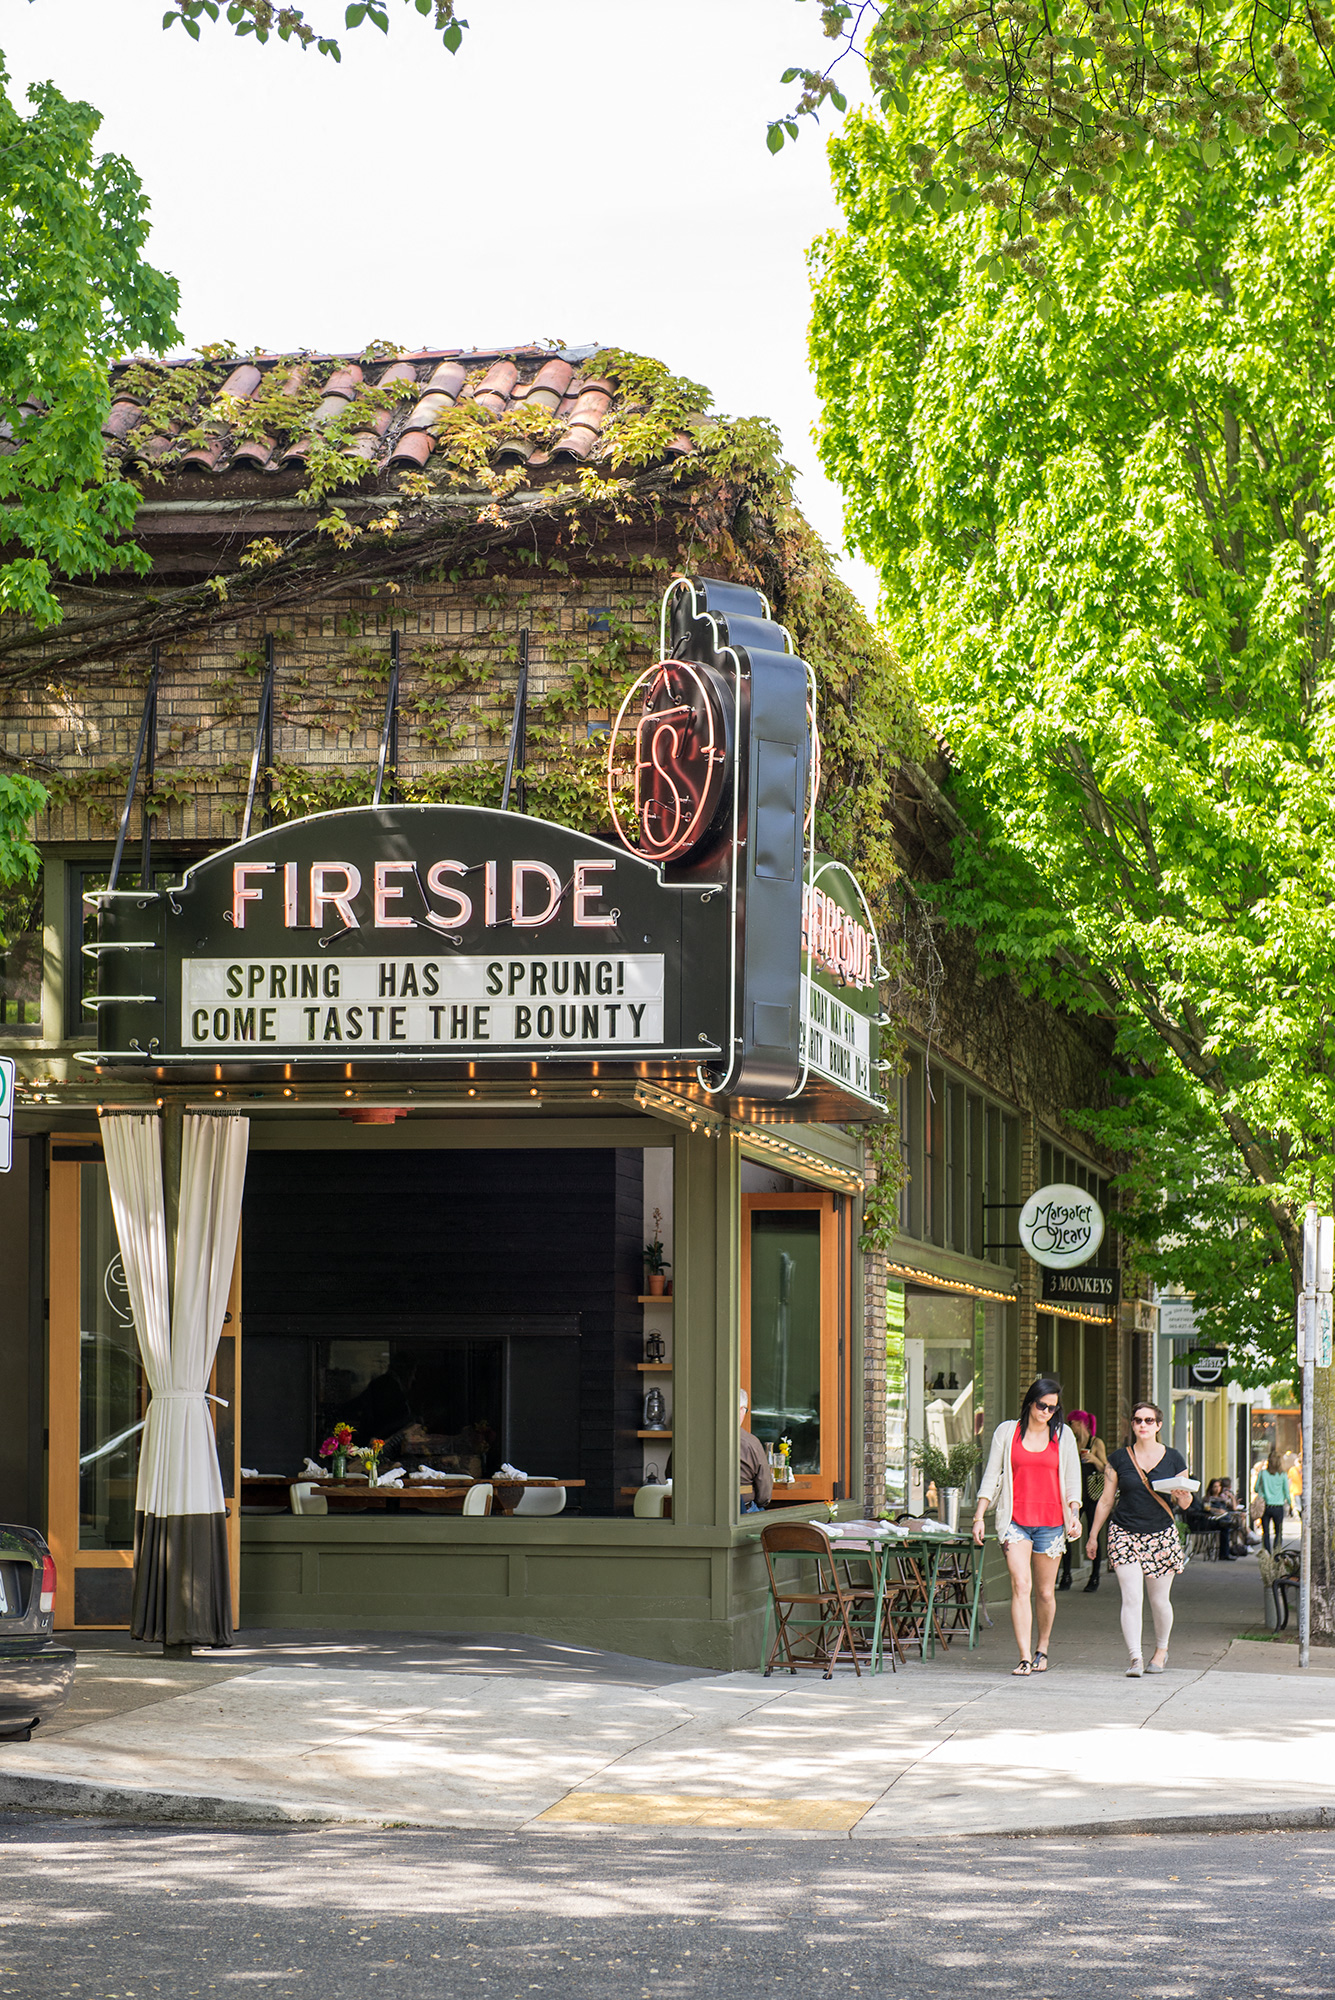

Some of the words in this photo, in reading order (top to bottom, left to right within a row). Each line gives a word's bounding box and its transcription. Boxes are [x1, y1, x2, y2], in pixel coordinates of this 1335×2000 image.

[233, 860, 617, 929] FIRESIDE
[226, 964, 340, 999] SPRING
[379, 962, 440, 997] HAS
[486, 960, 624, 996] SPRUNG!
[191, 1006, 277, 1042] COME
[303, 1006, 408, 1041] TASTE
[429, 1004, 490, 1040] THE
[514, 1003, 646, 1040] BOUNTY
[808, 983, 828, 1029] UNDAY
[830, 999, 842, 1037] MAY
[844, 1010, 855, 1046] 4TH
[799, 1020, 823, 1066] CHRITY
[829, 1038, 850, 1081] BRUNCH
[855, 1055, 868, 1091] 10-2
[1026, 1201, 1093, 1230] Margaret
[1050, 1276, 1057, 1292] 3
[1058, 1276, 1113, 1295] MONKEYS
[1195, 1358, 1222, 1368] ARISTA
